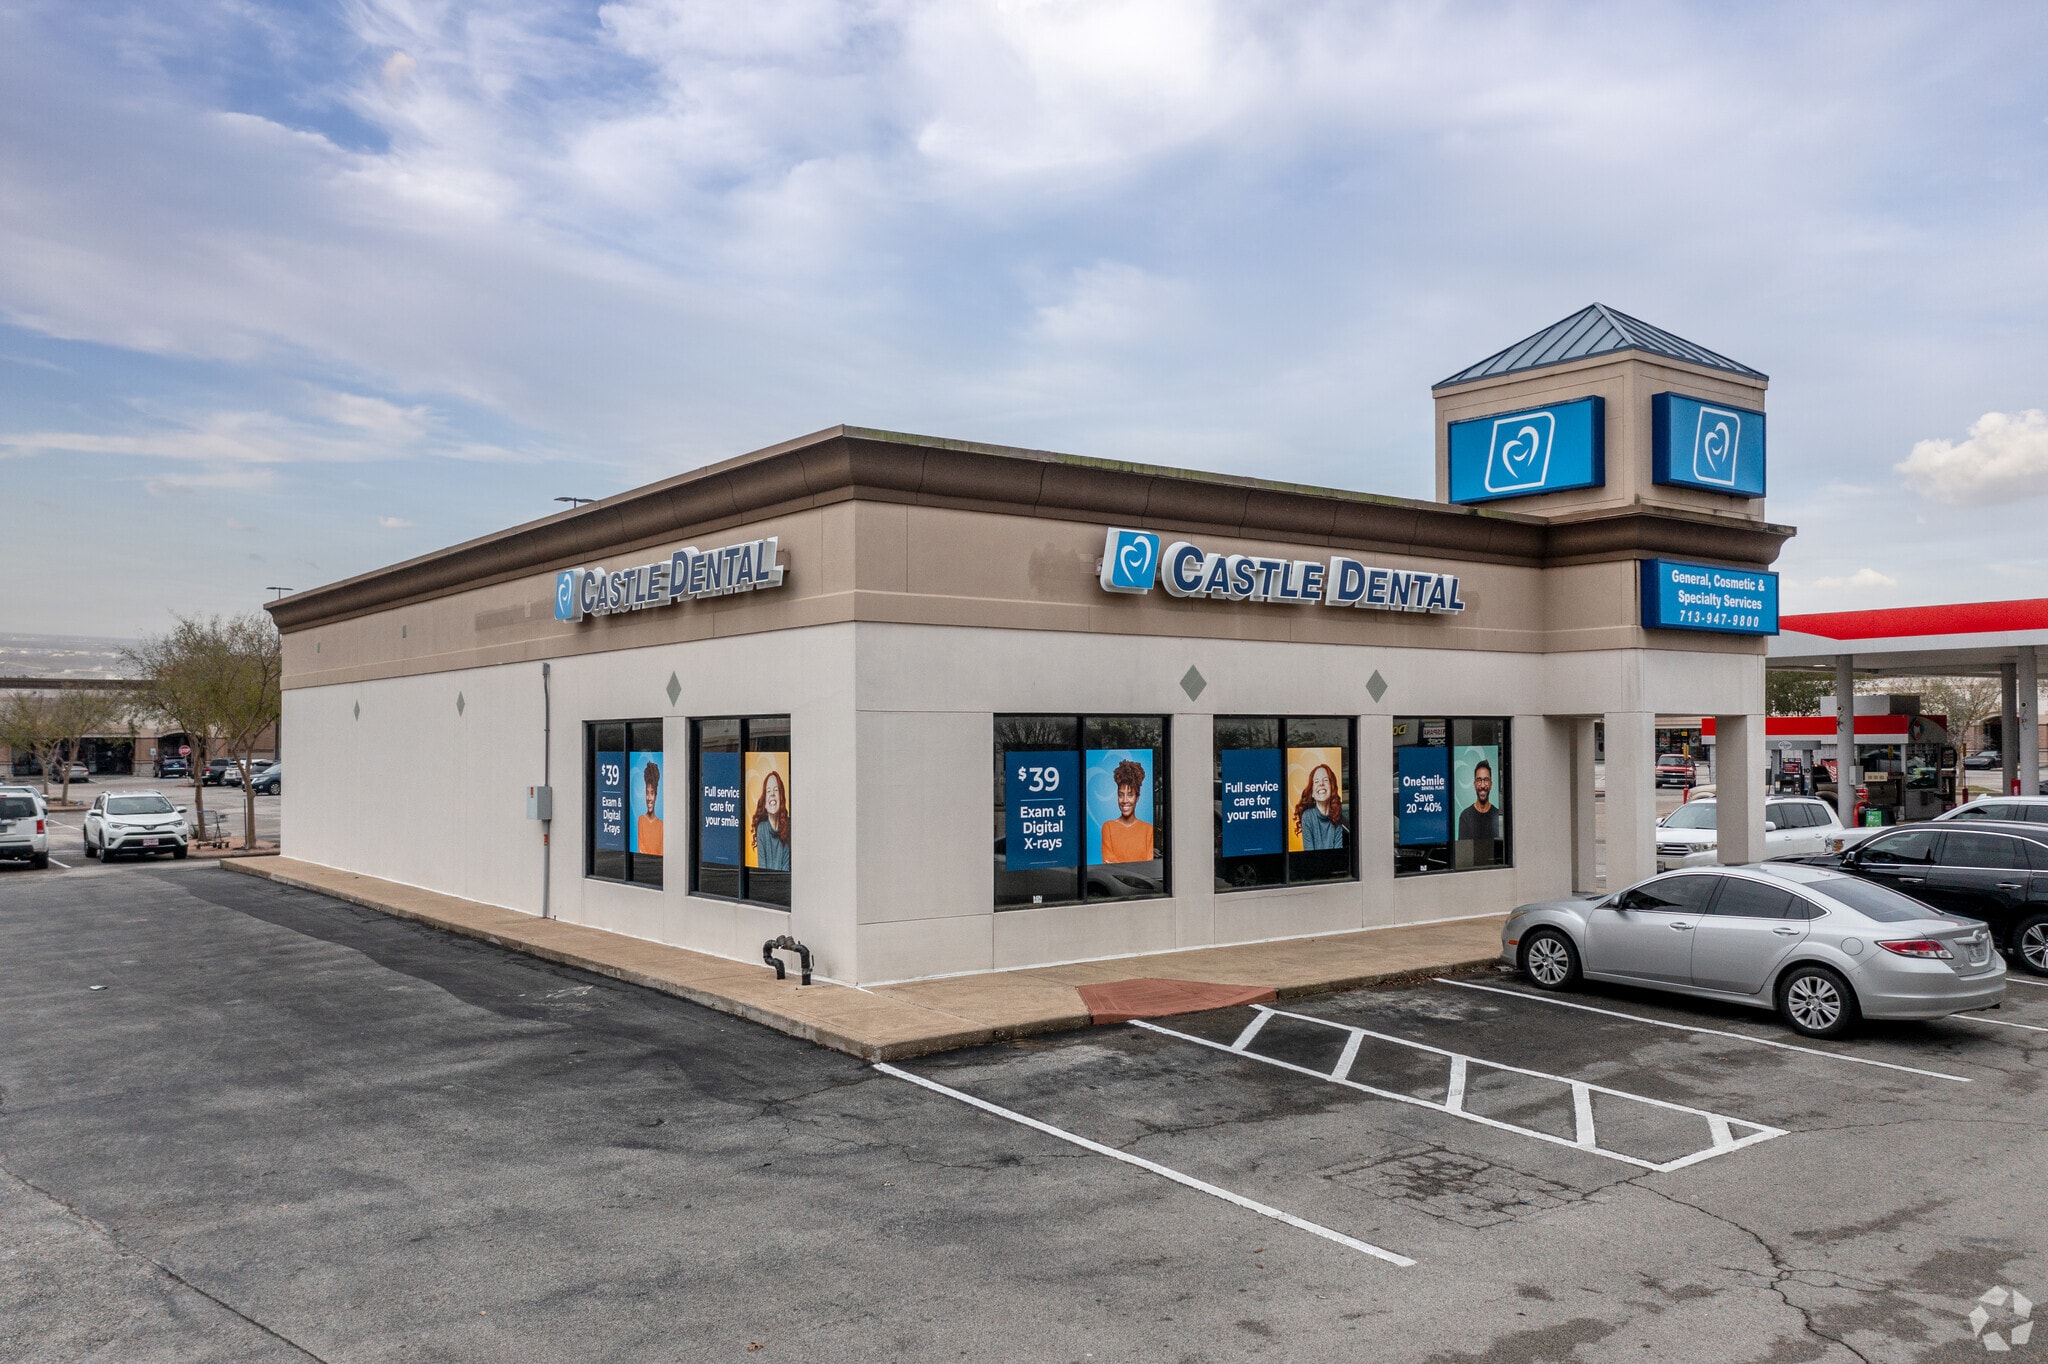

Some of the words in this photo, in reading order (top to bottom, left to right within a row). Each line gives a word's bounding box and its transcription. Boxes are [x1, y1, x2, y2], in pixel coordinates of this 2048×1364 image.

[580, 565, 661, 614] CASTLE
[669, 542, 769, 597] DENTAL
[1172, 545, 1325, 600] CASTLE
[1337, 559, 1465, 611] DENTAL
[1671, 569, 1711, 589] General,
[1713, 574, 1756, 591] Cosmetic
[1757, 579, 1765, 592] &
[1678, 590, 1722, 609] Specialty
[1723, 594, 1762, 610] Services
[1679, 610, 1759, 628] 713-947-9800
[601, 764, 620, 786] $39
[1018, 766, 1060, 792] $39
[1403, 774, 1445, 787] OneSmile
[704, 786, 716, 798] Full
[717, 787, 740, 798] service
[1225, 782, 1243, 794] Full
[1245, 781, 1279, 793] service
[602, 796, 617, 808] Exam
[617, 797, 622, 808] &
[1233, 797, 1255, 807] care
[1256, 795, 1270, 806] for
[1414, 792, 1434, 803] Save
[709, 803, 724, 812] care
[724, 801, 735, 812] for
[1020, 806, 1054, 819] Exam
[1057, 805, 1066, 817] &
[1406, 803, 1417, 814] 20
[1423, 802, 1442, 813] 40%
[603, 809, 621, 822] Digital
[705, 817, 720, 828] your
[721, 815, 739, 827] smile
[1227, 811, 1249, 824] your
[1251, 808, 1277, 819] smile
[603, 822, 621, 835] X-rays
[1023, 820, 1063, 836] Digital
[1024, 837, 1062, 851] X-rays
